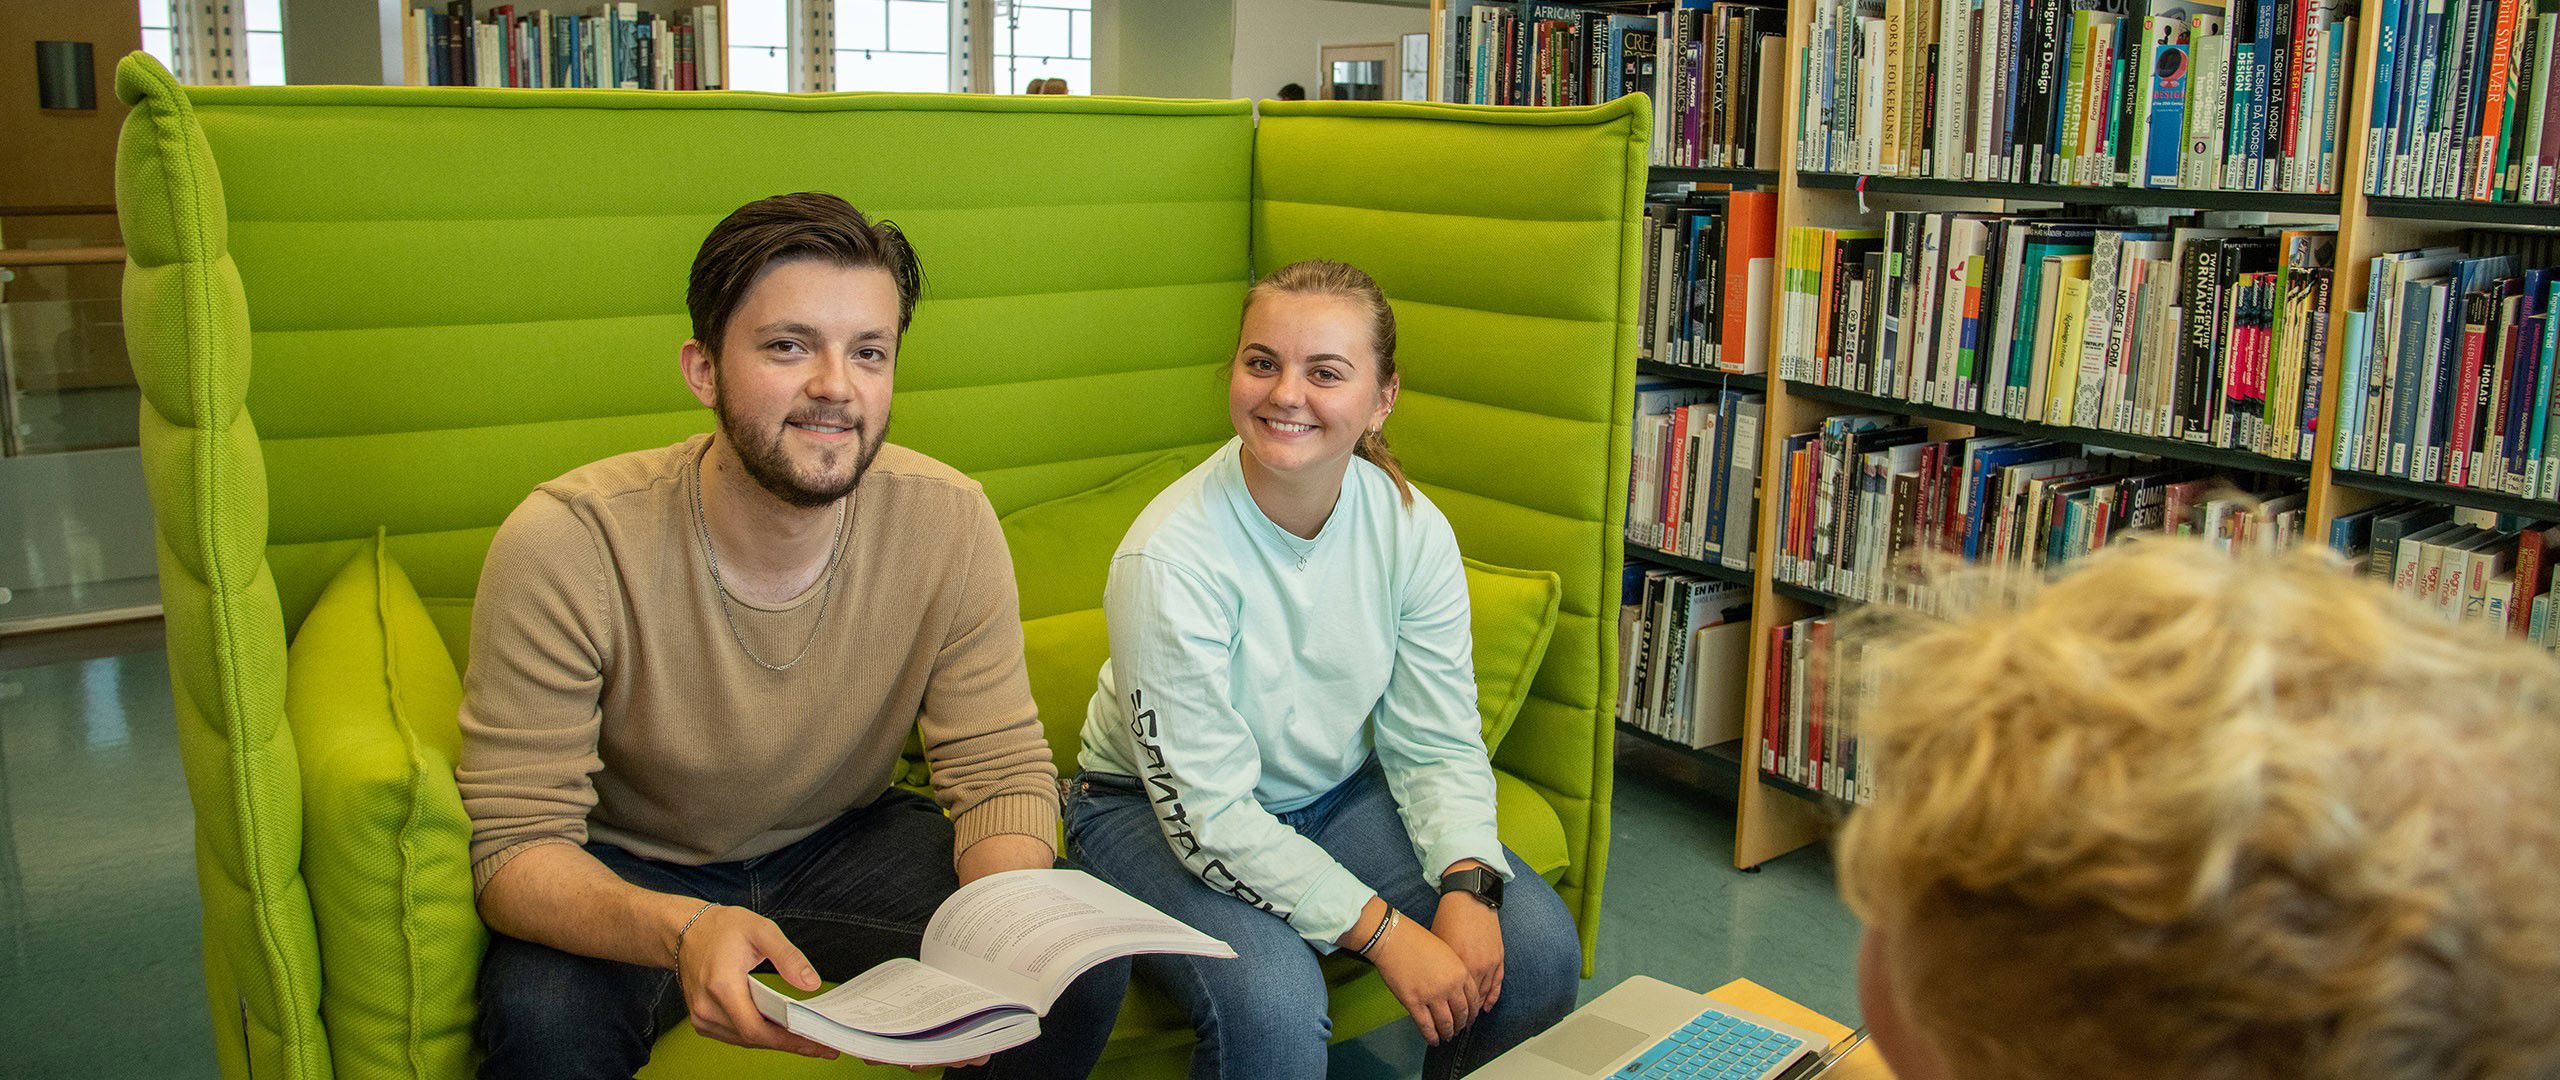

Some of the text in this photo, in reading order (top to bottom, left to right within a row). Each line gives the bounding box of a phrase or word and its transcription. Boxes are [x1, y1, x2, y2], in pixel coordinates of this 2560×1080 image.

[1842, 2, 1851, 41] SAMISK
[1906, 11, 1917, 54] NORSK
[1986, 7, 1999, 60] NORSKE
[2001, 4, 2010, 24] ARTS
[2465, 5, 2481, 55] BILLEDVEV
[1515, 21, 1525, 84] AFRICAN MASKS
[1593, 24, 1601, 65] MILLERS
[1999, 37, 2008, 58] CRAFTS
[2008, 5, 2021, 73] ART DECO FUNKIS
[2037, 0, 2057, 95] signer's Design
[2305, 1, 2321, 74] DESIGN
[2487, 0, 2514, 103] Britt SMELVÆR
[1677, 15, 1689, 113] STUDIO CERAMICS
[1713, 38, 1725, 111] NAKED CLAY
[1839, 42, 1849, 80] KULTUR
[1884, 16, 1899, 148] NORSK FOLKEKUNST
[1912, 11, 1929, 150] NORSK FOLKEKUNST
[2089, 40, 2106, 122] Forms with Fantasy
[2125, 44, 2140, 115] Formens rörelse
[2235, 52, 2246, 92] DESIGN
[2245, 52, 2255, 92] DESIGN
[2291, 40, 2303, 89] IMPULSER
[2419, 63, 2432, 97] FRIDA
[1839, 82, 1847, 96] OG
[1952, 30, 1966, 141] FOLK ART OF EUROPE
[2192, 76, 2207, 132] handbook
[2201, 56, 2215, 133] the eco-design
[2216, 60, 2228, 131] COLOR AND VALUE
[2267, 49, 2285, 141] DESIGN PÅ NORSK
[2325, 59, 2340, 143] PLASTICS HANDBOOK
[2069, 80, 2085, 148] TINGENES
[2249, 65, 2266, 157] DESIGN PÅ NORSK
[2412, 139, 2420, 165] 746.39481
[2440, 133, 2450, 162] 746.39481
[2447, 153, 2458, 182] 746.39481
[2483, 138, 2492, 165] 746.39481
[2522, 162, 2533, 197] 746.41 Mor
[2541, 167, 2549, 187] 746.42
[1891, 254, 1900, 275] CIRCUS
[1901, 222, 1916, 319] Package Design Japan
[1924, 266, 1932, 289] Product
[1922, 291, 1930, 311] Design
[2114, 289, 2127, 327] NORGE
[2192, 252, 2210, 349] ORNAMENT
[2222, 288, 2231, 309] Water
[2367, 273, 2377, 313] Thread Magic
[1942, 288, 1960, 376] History of Modern Design
[2180, 308, 2190, 357] ORNAMENT
[2220, 311, 2230, 335] Colour
[2545, 291, 2560, 349] Tegne med tråd
[2108, 337, 2121, 369] FORM
[2217, 347, 2227, 379] Porcelain
[2307, 278, 2329, 409] FORMGIVINGSAKTIVITETER
[2372, 326, 2386, 379] EMBROIDERY
[2228, 350, 2239, 386] through craft
[2245, 350, 2255, 386] through craft
[2259, 357, 2269, 395] through craft
[2396, 320, 2421, 439] Inspiration for Embroidery
[2458, 334, 2477, 431] NEEDLEWORK THROUGH
[2478, 363, 2492, 406] ¡MOLAS!
[2337, 432, 2347, 454] 746.44
[2380, 437, 2388, 456] 746.44
[2517, 412, 2530, 452] SOURCEBOOK
[2429, 448, 2438, 468] 746.44
[2452, 451, 2461, 470] 746.44
[2526, 463, 2535, 484] 746.44
[1668, 437, 1684, 523] Drawing and Painting
[2405, 561, 2417, 586] tegne
[2428, 566, 2440, 592] tegne
[2449, 570, 2462, 597] tegne
[1638, 620, 1652, 679] CRAFTS
[1131, 708, 1201, 861] SANTA
